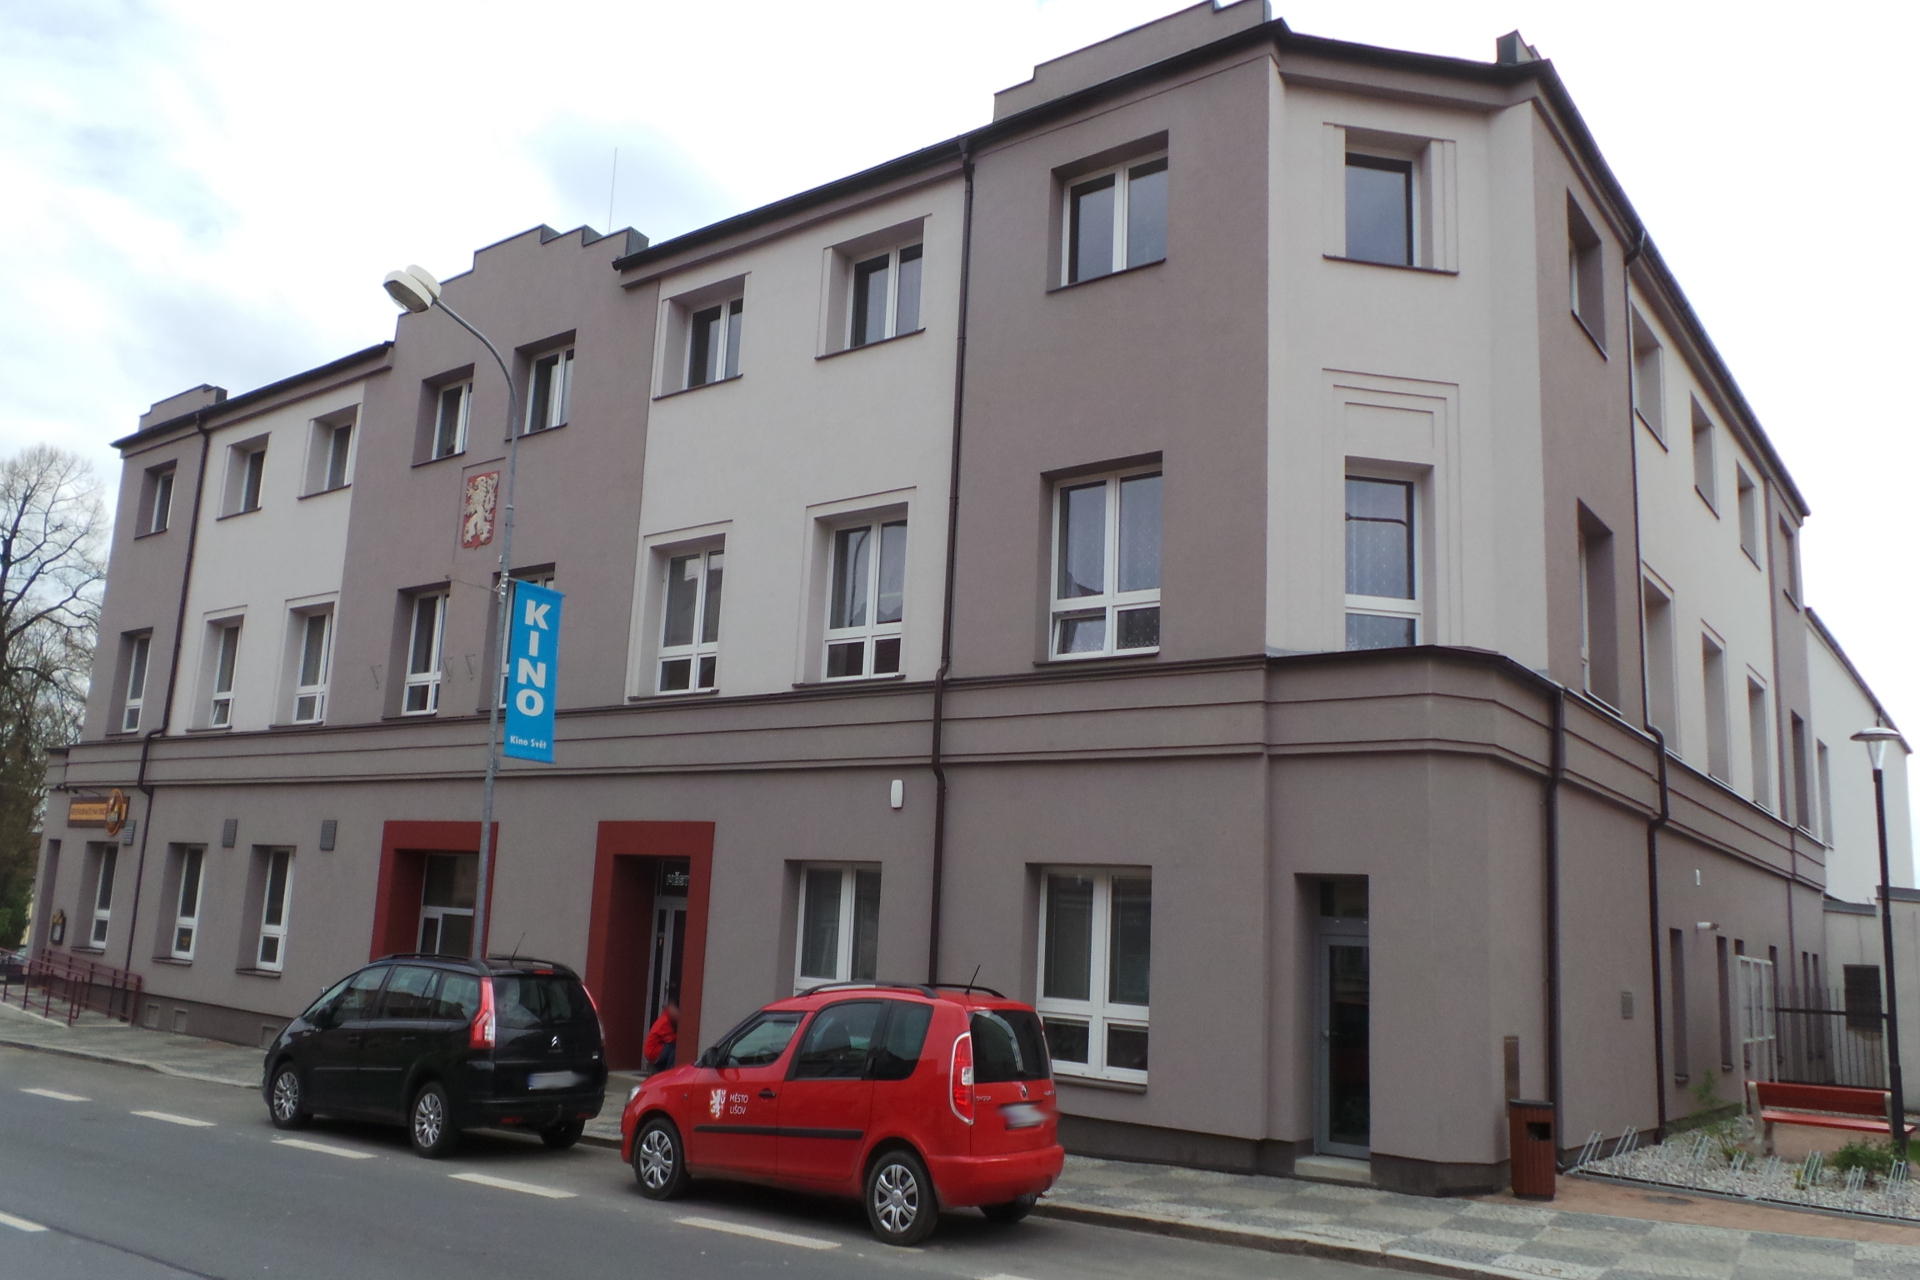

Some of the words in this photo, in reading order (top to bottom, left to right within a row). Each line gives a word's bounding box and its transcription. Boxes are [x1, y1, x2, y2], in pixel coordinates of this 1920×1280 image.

[516, 599, 551, 717] KINO
[510, 735, 528, 746] Kino
[530, 738, 547, 749] Svět
[729, 1092, 749, 1103] MĚSTO
[729, 1104, 747, 1115] LIŠOV
